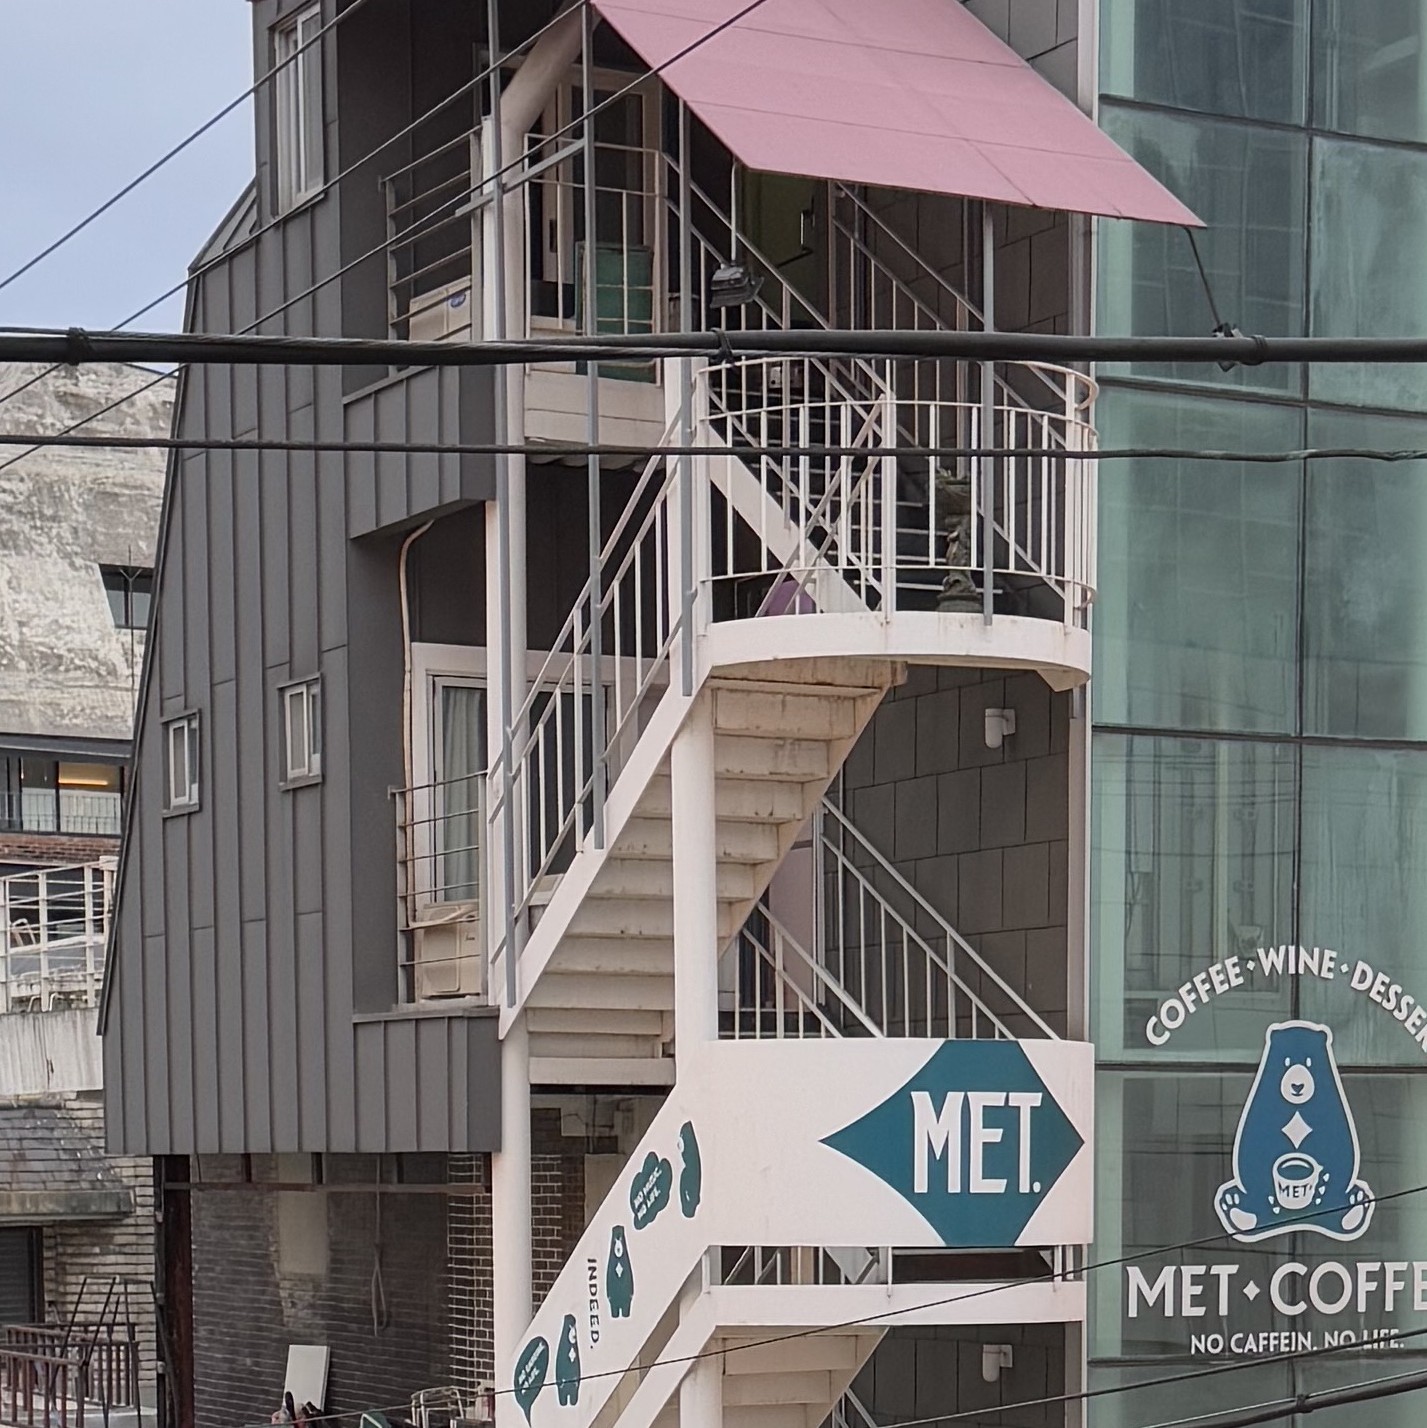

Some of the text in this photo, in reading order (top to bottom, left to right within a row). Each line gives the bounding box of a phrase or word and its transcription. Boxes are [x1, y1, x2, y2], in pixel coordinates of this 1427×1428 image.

[1145, 955, 1245, 1046] COFFEE
[1257, 945, 1338, 979] WINE
[910, 1091, 1043, 1195] MET.
[587, 1258, 600, 1349] INDEED.
[1126, 1264, 1240, 1318] MET
[1191, 1334, 1224, 1355] NO
[1324, 1330, 1357, 1351] NO
